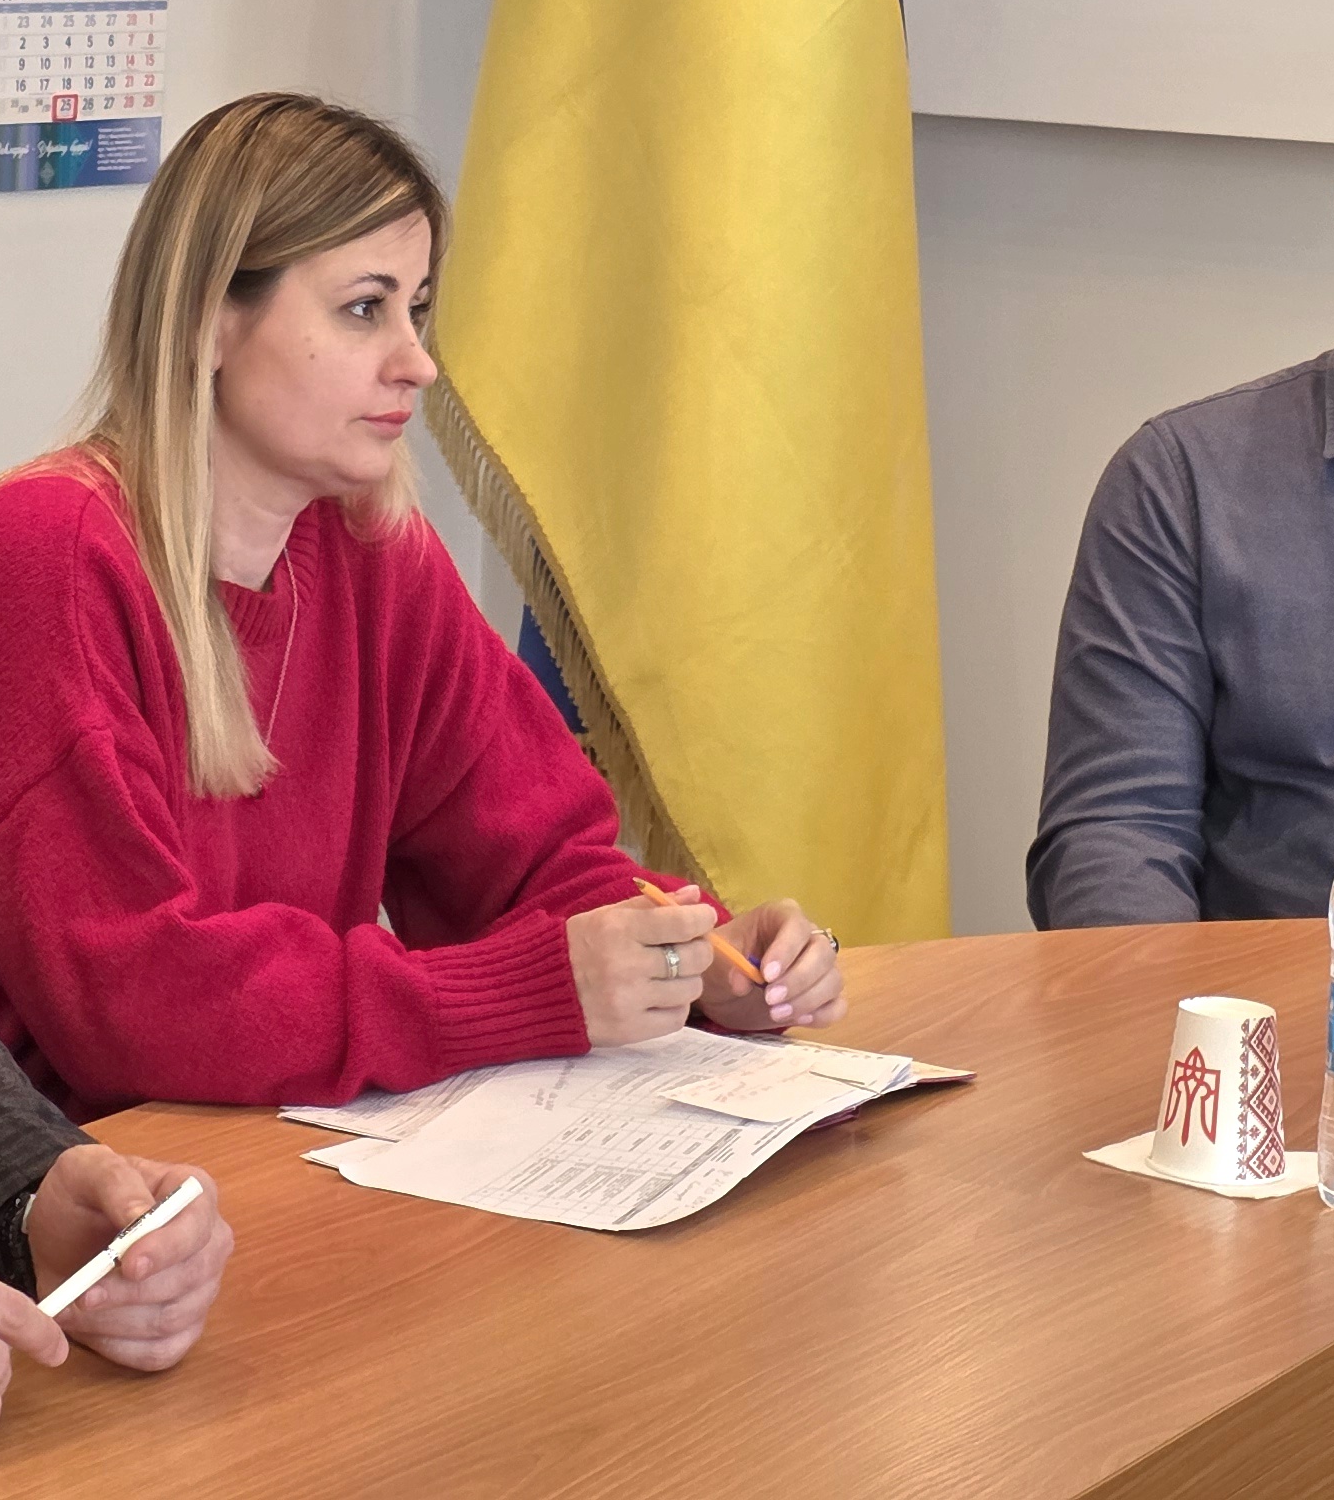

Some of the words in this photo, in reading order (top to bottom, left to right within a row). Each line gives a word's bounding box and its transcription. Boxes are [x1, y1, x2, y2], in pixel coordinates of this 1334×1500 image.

[19, 36, 26, 50] 2
[43, 36, 50, 49] 3
[65, 36, 72, 48] 4
[86, 35, 93, 48] 5
[108, 34, 115, 47] 6
[18, 58, 25, 71] 9
[40, 57, 51, 70] 10
[63, 57, 72, 70] 11
[84, 56, 95, 69] 12
[106, 55, 116, 68] 13
[126, 54, 135, 67] 14
[145, 54, 155, 66] 15
[15, 79, 27, 93] 16
[39, 78, 50, 91] 17
[62, 78, 72, 90] 18
[84, 77, 94, 90] 19
[104, 76, 116, 89] 20
[82, 98, 94, 111] 26
[103, 97, 115, 109] 27
